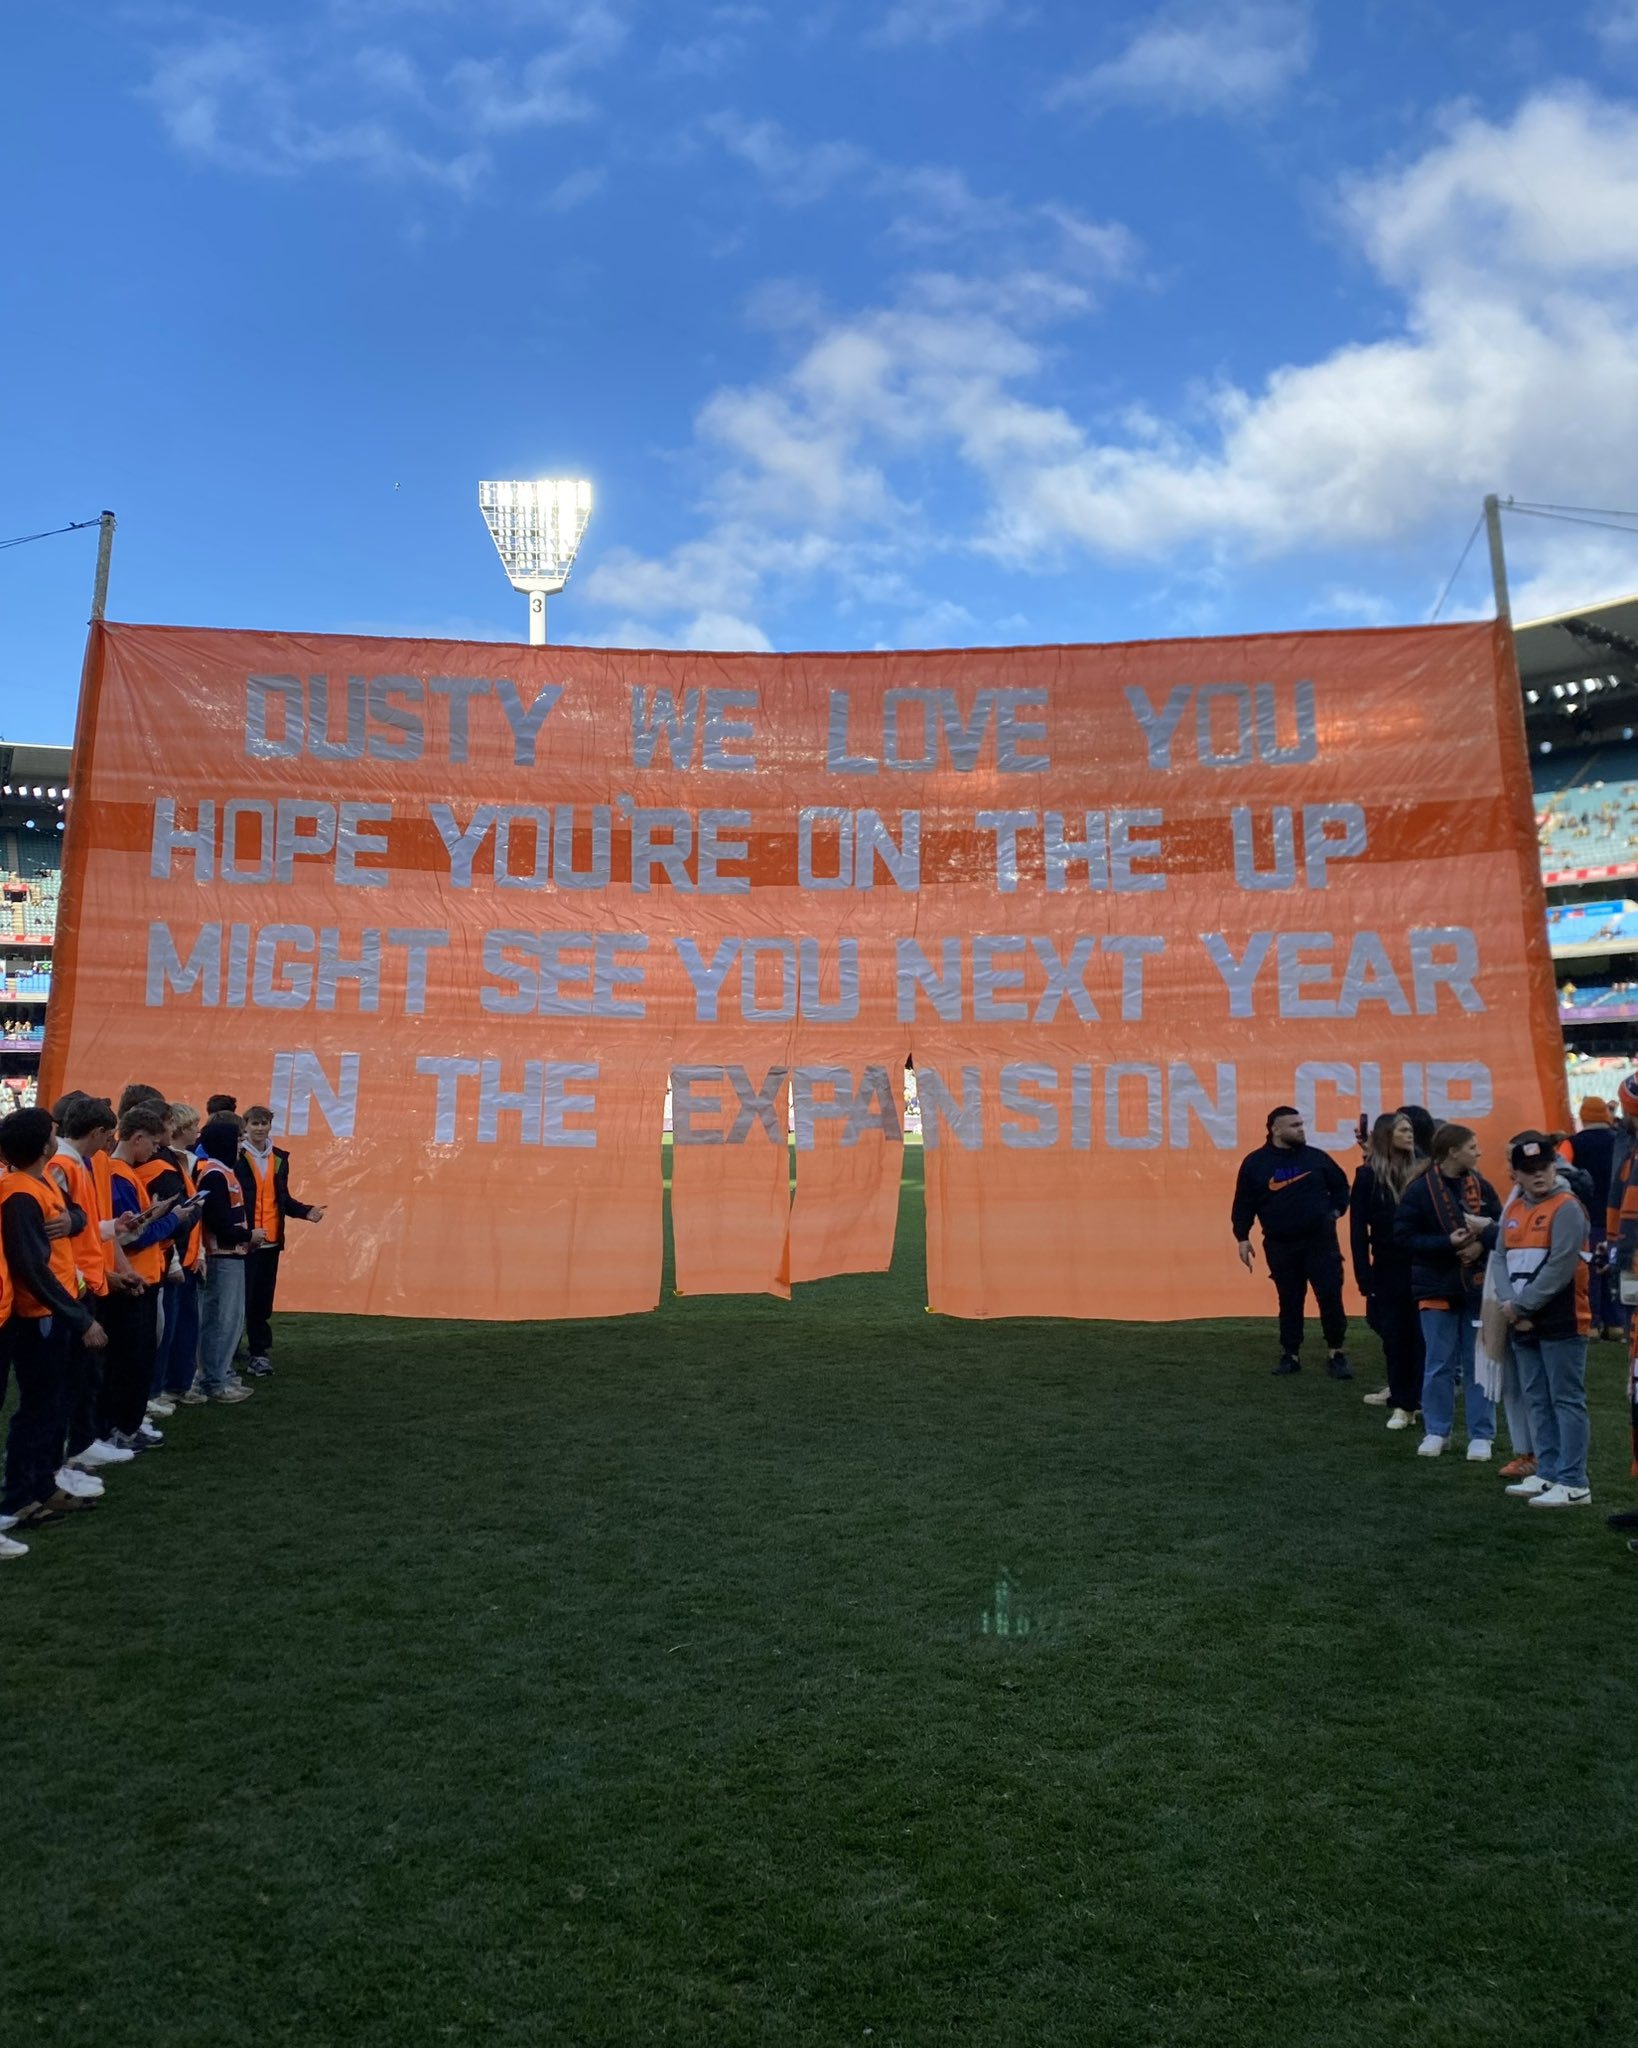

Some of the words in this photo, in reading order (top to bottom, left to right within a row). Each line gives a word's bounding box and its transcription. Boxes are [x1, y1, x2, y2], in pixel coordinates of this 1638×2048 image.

[532, 598, 542, 613] 3
[244, 674, 564, 767] DUSTY
[632, 685, 758, 772] WE
[827, 688, 1051, 774] LOVE
[1124, 681, 1318, 770] YOU
[150, 798, 392, 887] HOPE
[428, 793, 752, 893] YOU'RE
[799, 806, 920, 892] ON
[974, 808, 1167, 893] THE
[1231, 803, 1367, 890] UP
[145, 922, 449, 1014] MIGHT
[479, 929, 648, 1019] SEE
[675, 936, 861, 1022] YOU
[895, 935, 1165, 1022] NEXT
[1201, 926, 1487, 1018] YEAR
[268, 1051, 361, 1138] IN
[416, 1056, 598, 1147] THE
[671, 1062, 1237, 1152] EXPANSION
